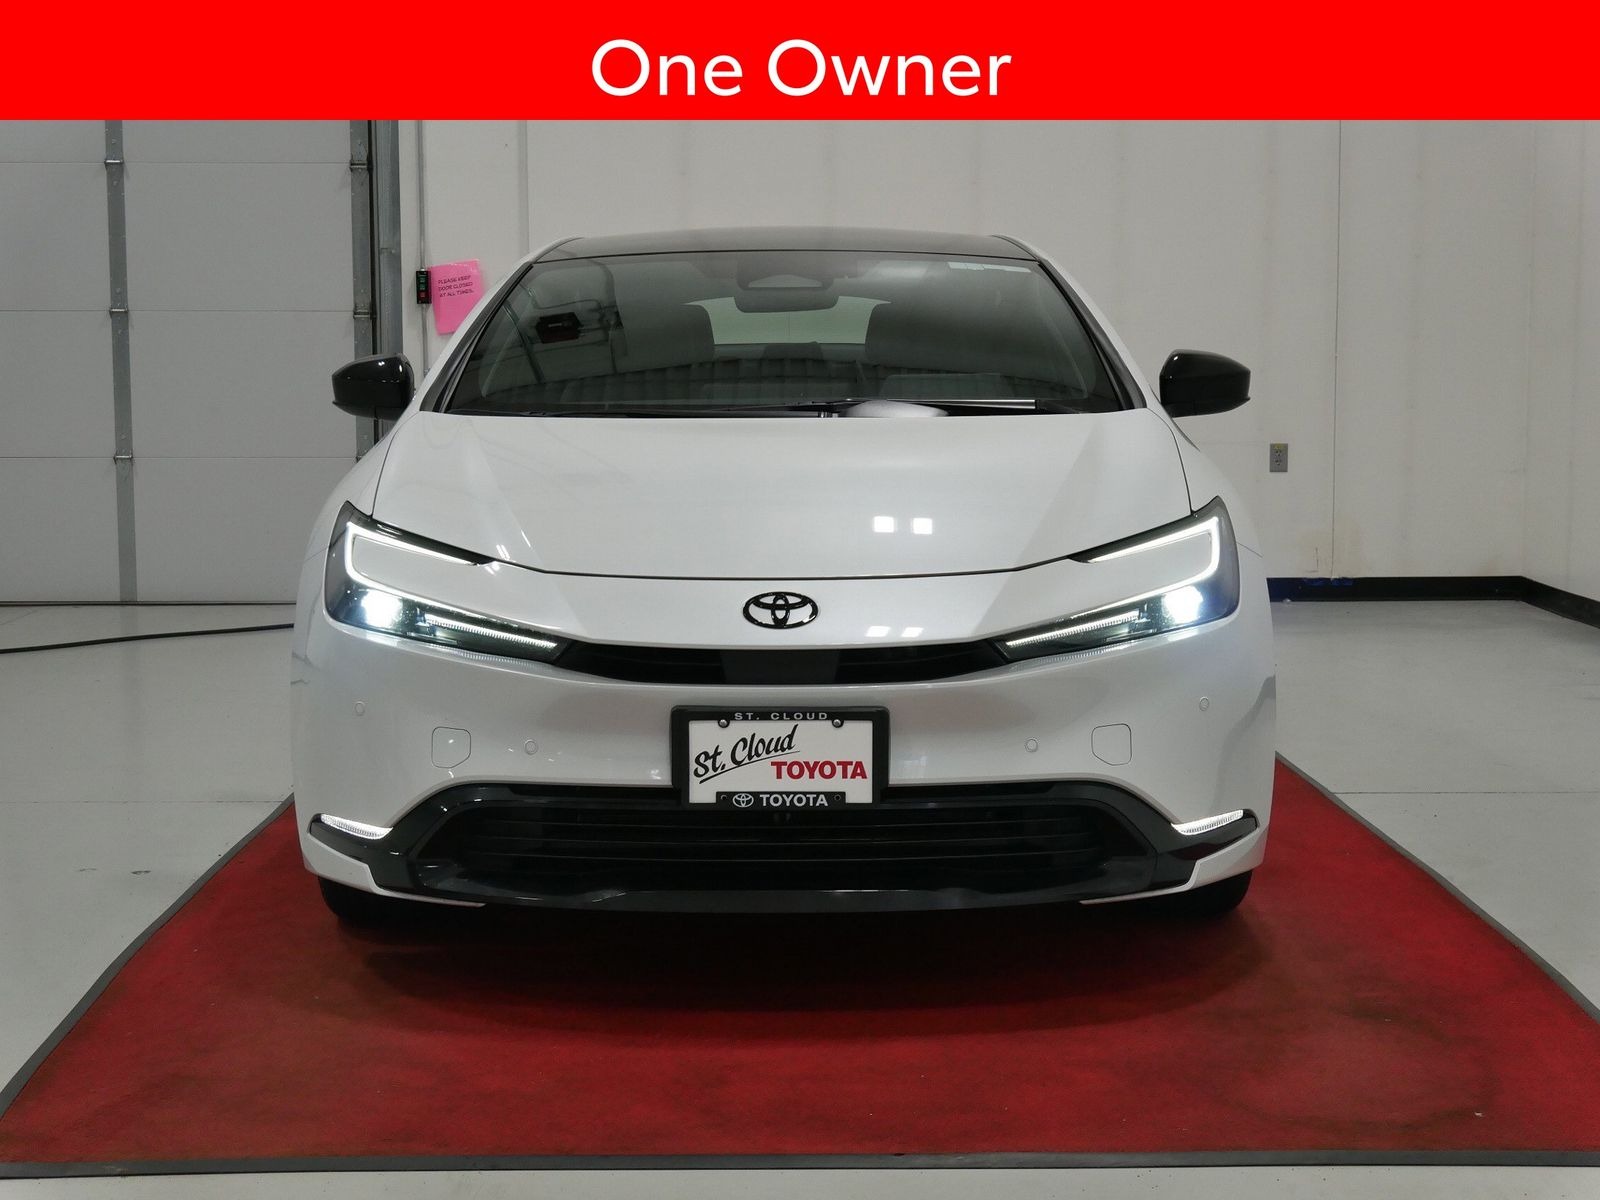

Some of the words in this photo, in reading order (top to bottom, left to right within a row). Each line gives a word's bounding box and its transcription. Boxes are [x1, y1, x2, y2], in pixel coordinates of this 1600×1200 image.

[734, 712, 760, 721] ST.
[770, 712, 828, 721] CLOUD
[693, 745, 726, 778] St.
[730, 724, 799, 766] Cloud
[770, 760, 868, 780] TOYOTA
[759, 794, 829, 807] TOYOTA
